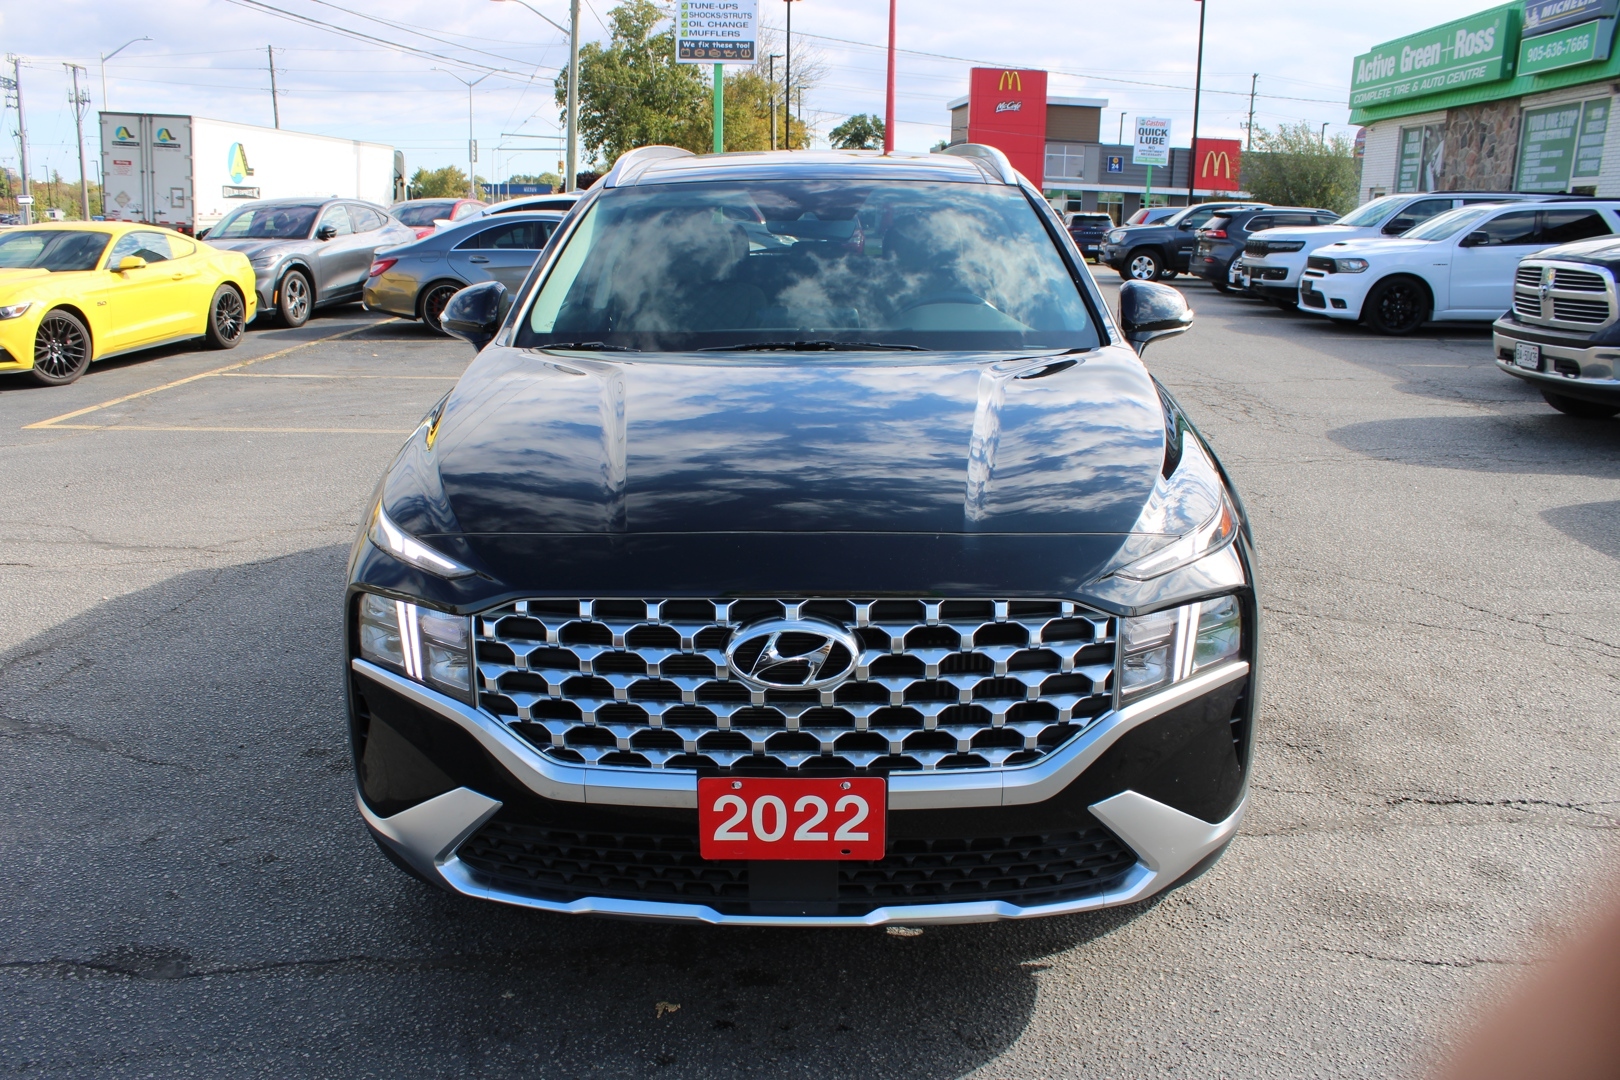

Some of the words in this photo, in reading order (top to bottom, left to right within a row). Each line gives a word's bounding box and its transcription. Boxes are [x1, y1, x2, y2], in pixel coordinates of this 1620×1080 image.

[689, 2, 739, 10] TUNE-UPS
[689, 11, 753, 19] SHOCKS/STRUTS
[1526, 34, 1590, 63] 905-636-7666
[1355, 54, 1396, 85] Active
[1400, 42, 1441, 74] Green
[1353, 87, 1392, 105] COMPLETE
[1393, 83, 1411, 95] TIRE
[1411, 82, 1418, 92] &
[1420, 75, 1445, 90] AUTO
[1446, 65, 1488, 84] CENTRE
[1145, 119, 1167, 127] Castrol
[1138, 127, 1168, 137] QUICK
[1139, 136, 1165, 145] LUBE
[712, 794, 870, 842] 2022
